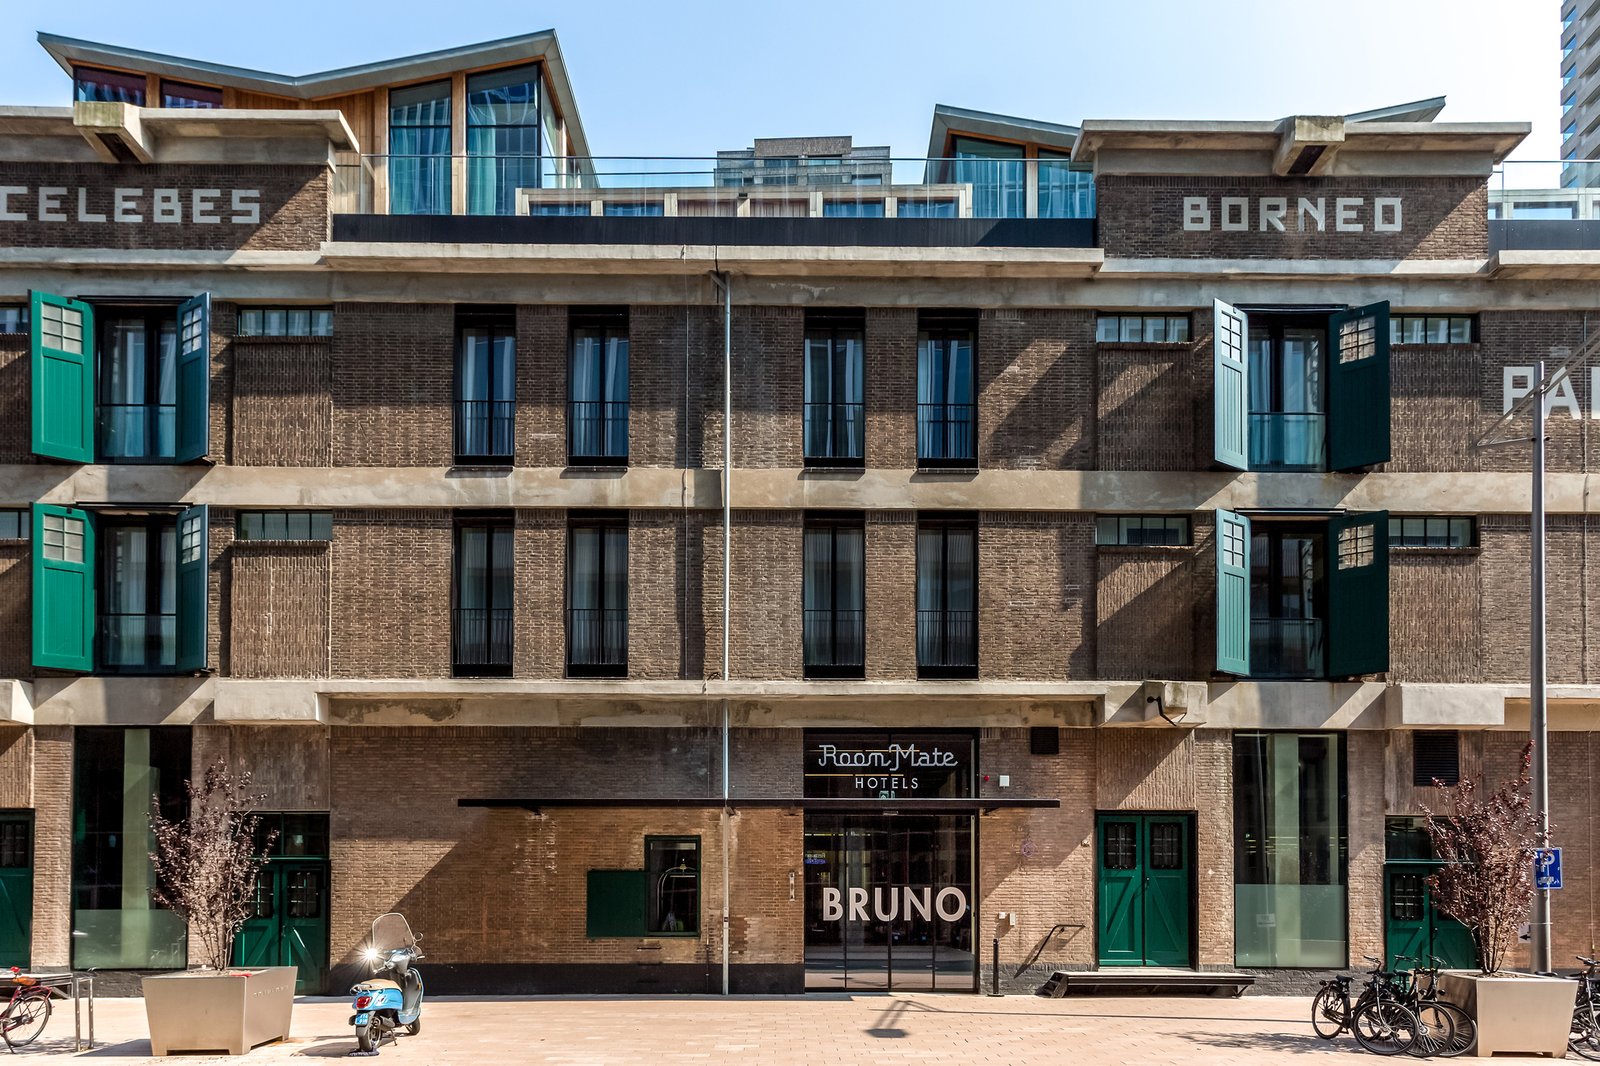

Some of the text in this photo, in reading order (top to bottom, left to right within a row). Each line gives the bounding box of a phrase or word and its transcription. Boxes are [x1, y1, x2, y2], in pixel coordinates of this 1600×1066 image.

[0, 186, 260, 223] CELEBES
[1183, 197, 1402, 232] BORNEO
[1503, 366, 1600, 420] PA
[818, 743, 959, 771] Room Mate
[855, 777, 919, 789] HOTELS
[823, 886, 967, 922] BRUNO
